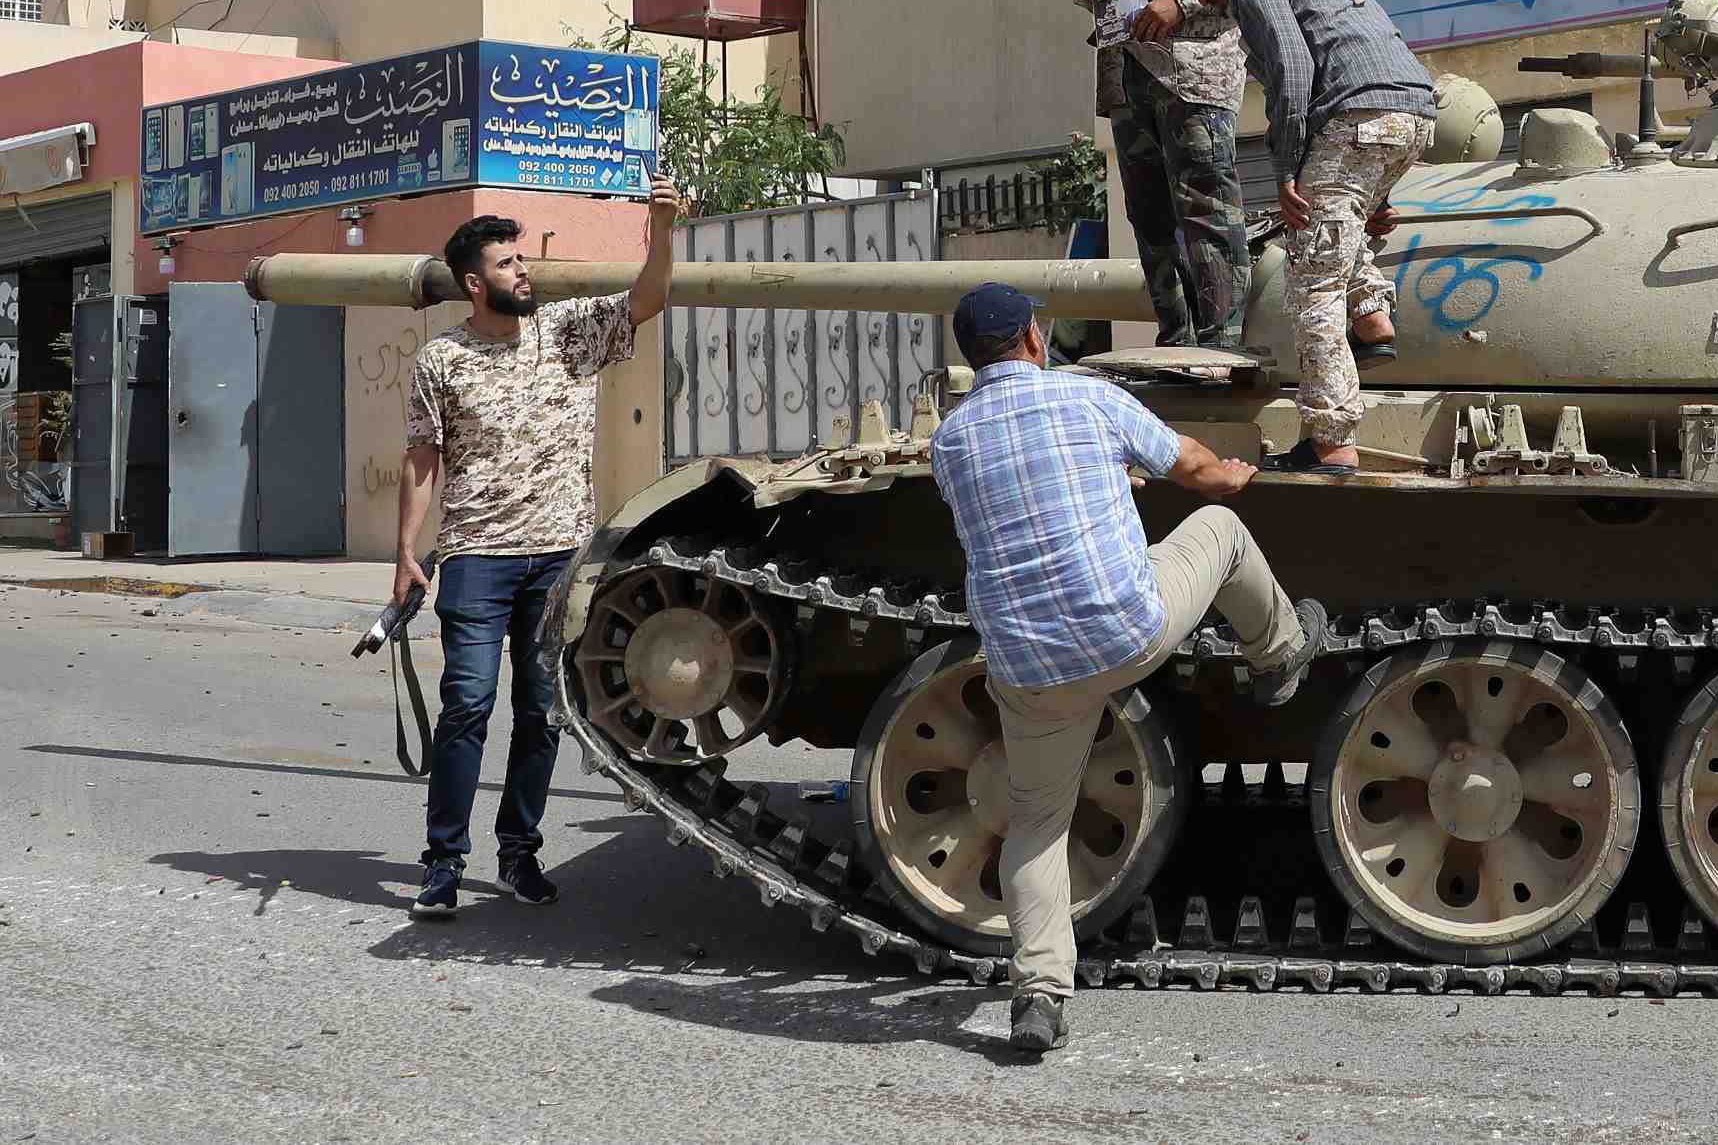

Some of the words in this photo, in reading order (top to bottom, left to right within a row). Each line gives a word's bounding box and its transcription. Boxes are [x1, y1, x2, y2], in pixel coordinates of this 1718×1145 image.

[484, 116, 546, 139] وكمالياته
[548, 121, 583, 140] النقال
[584, 123, 622, 144] للهاتف
[332, 137, 371, 166] النقال
[373, 129, 420, 154] للهاتف
[263, 147, 330, 175] وكمالياته
[519, 160, 540, 172] 092
[544, 161, 565, 174] 400
[568, 164, 596, 175] 2050
[264, 186, 279, 203] 092
[282, 183, 297, 200] 400
[299, 179, 320, 198] 2050
[331, 175, 348, 193] 092
[350, 172, 366, 190] 811
[368, 167, 390, 187] 1701
[518, 173, 540, 184] 092
[544, 175, 564, 186] 811
[569, 177, 595, 187] 1701
